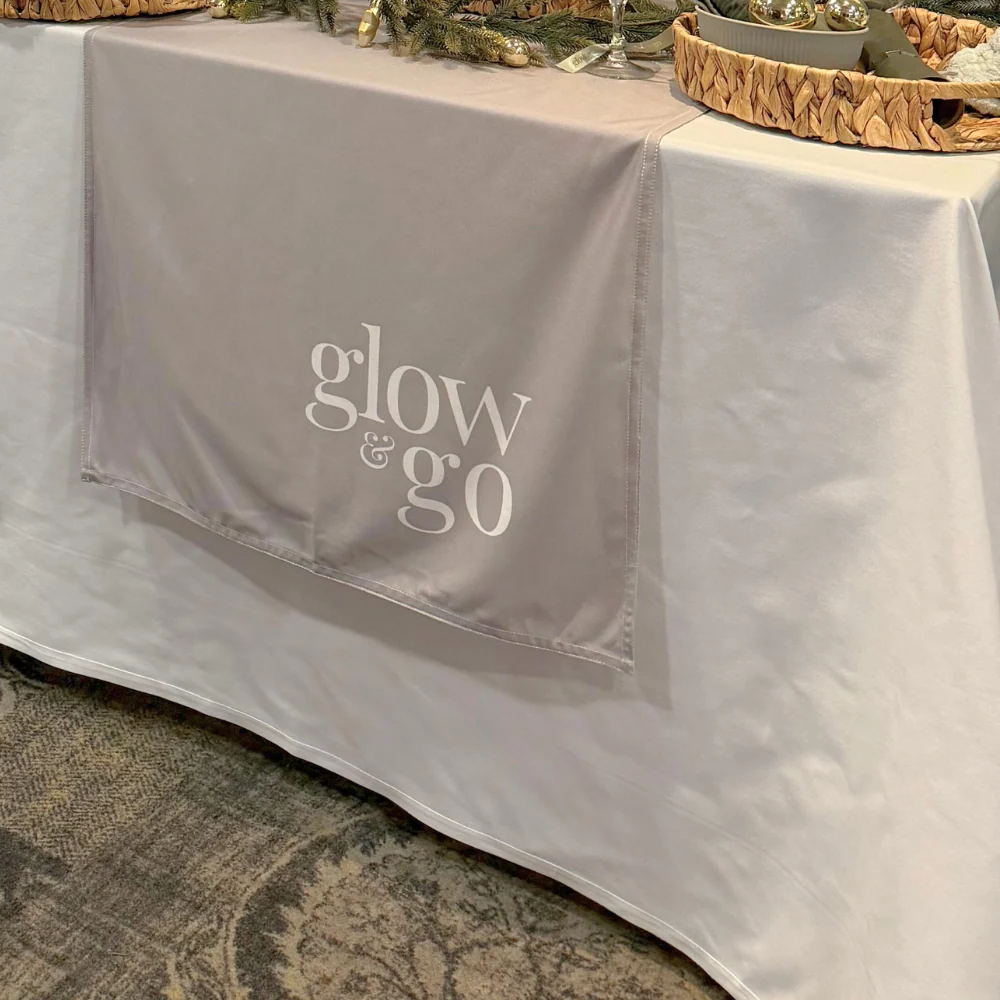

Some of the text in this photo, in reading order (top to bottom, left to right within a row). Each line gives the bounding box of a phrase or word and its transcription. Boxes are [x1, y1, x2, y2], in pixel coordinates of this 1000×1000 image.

[305, 322, 532, 456] glow
[359, 431, 513, 537] & go
